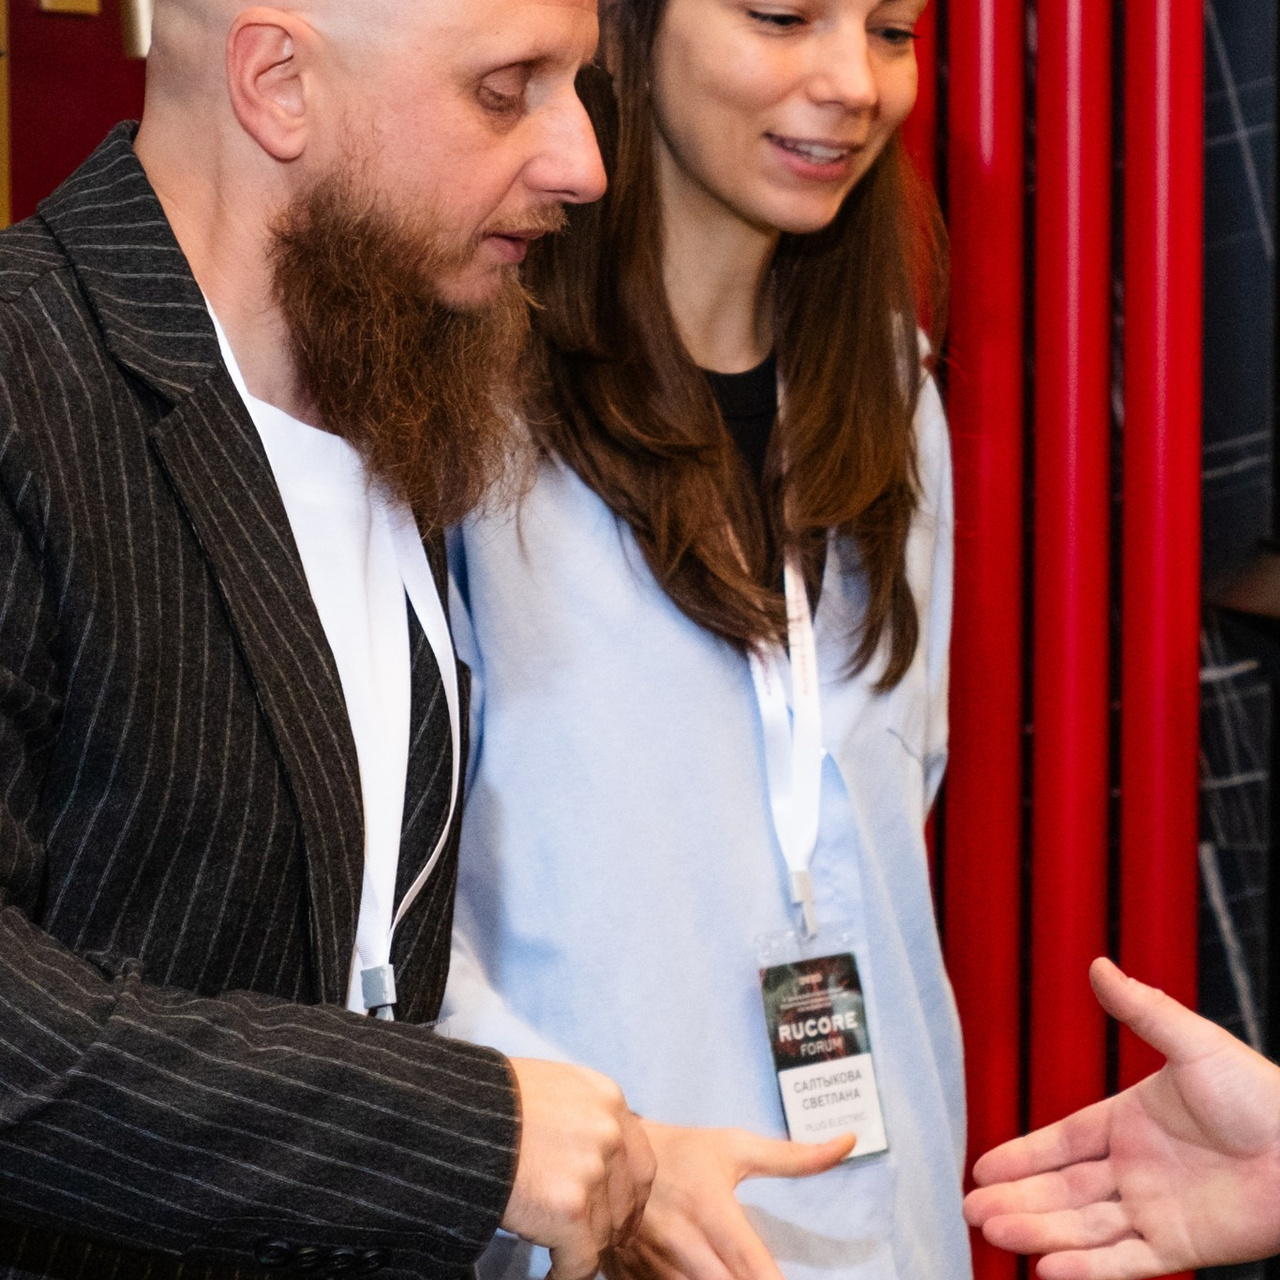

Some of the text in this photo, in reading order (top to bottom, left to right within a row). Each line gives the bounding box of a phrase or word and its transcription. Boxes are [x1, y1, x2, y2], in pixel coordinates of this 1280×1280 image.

[778, 1011, 858, 1043] RUCORE
[800, 1036, 844, 1056] FORUM
[794, 1069, 862, 1093] САЛТЫКОВА
[802, 1088, 861, 1110] СВЕТЛАНА
